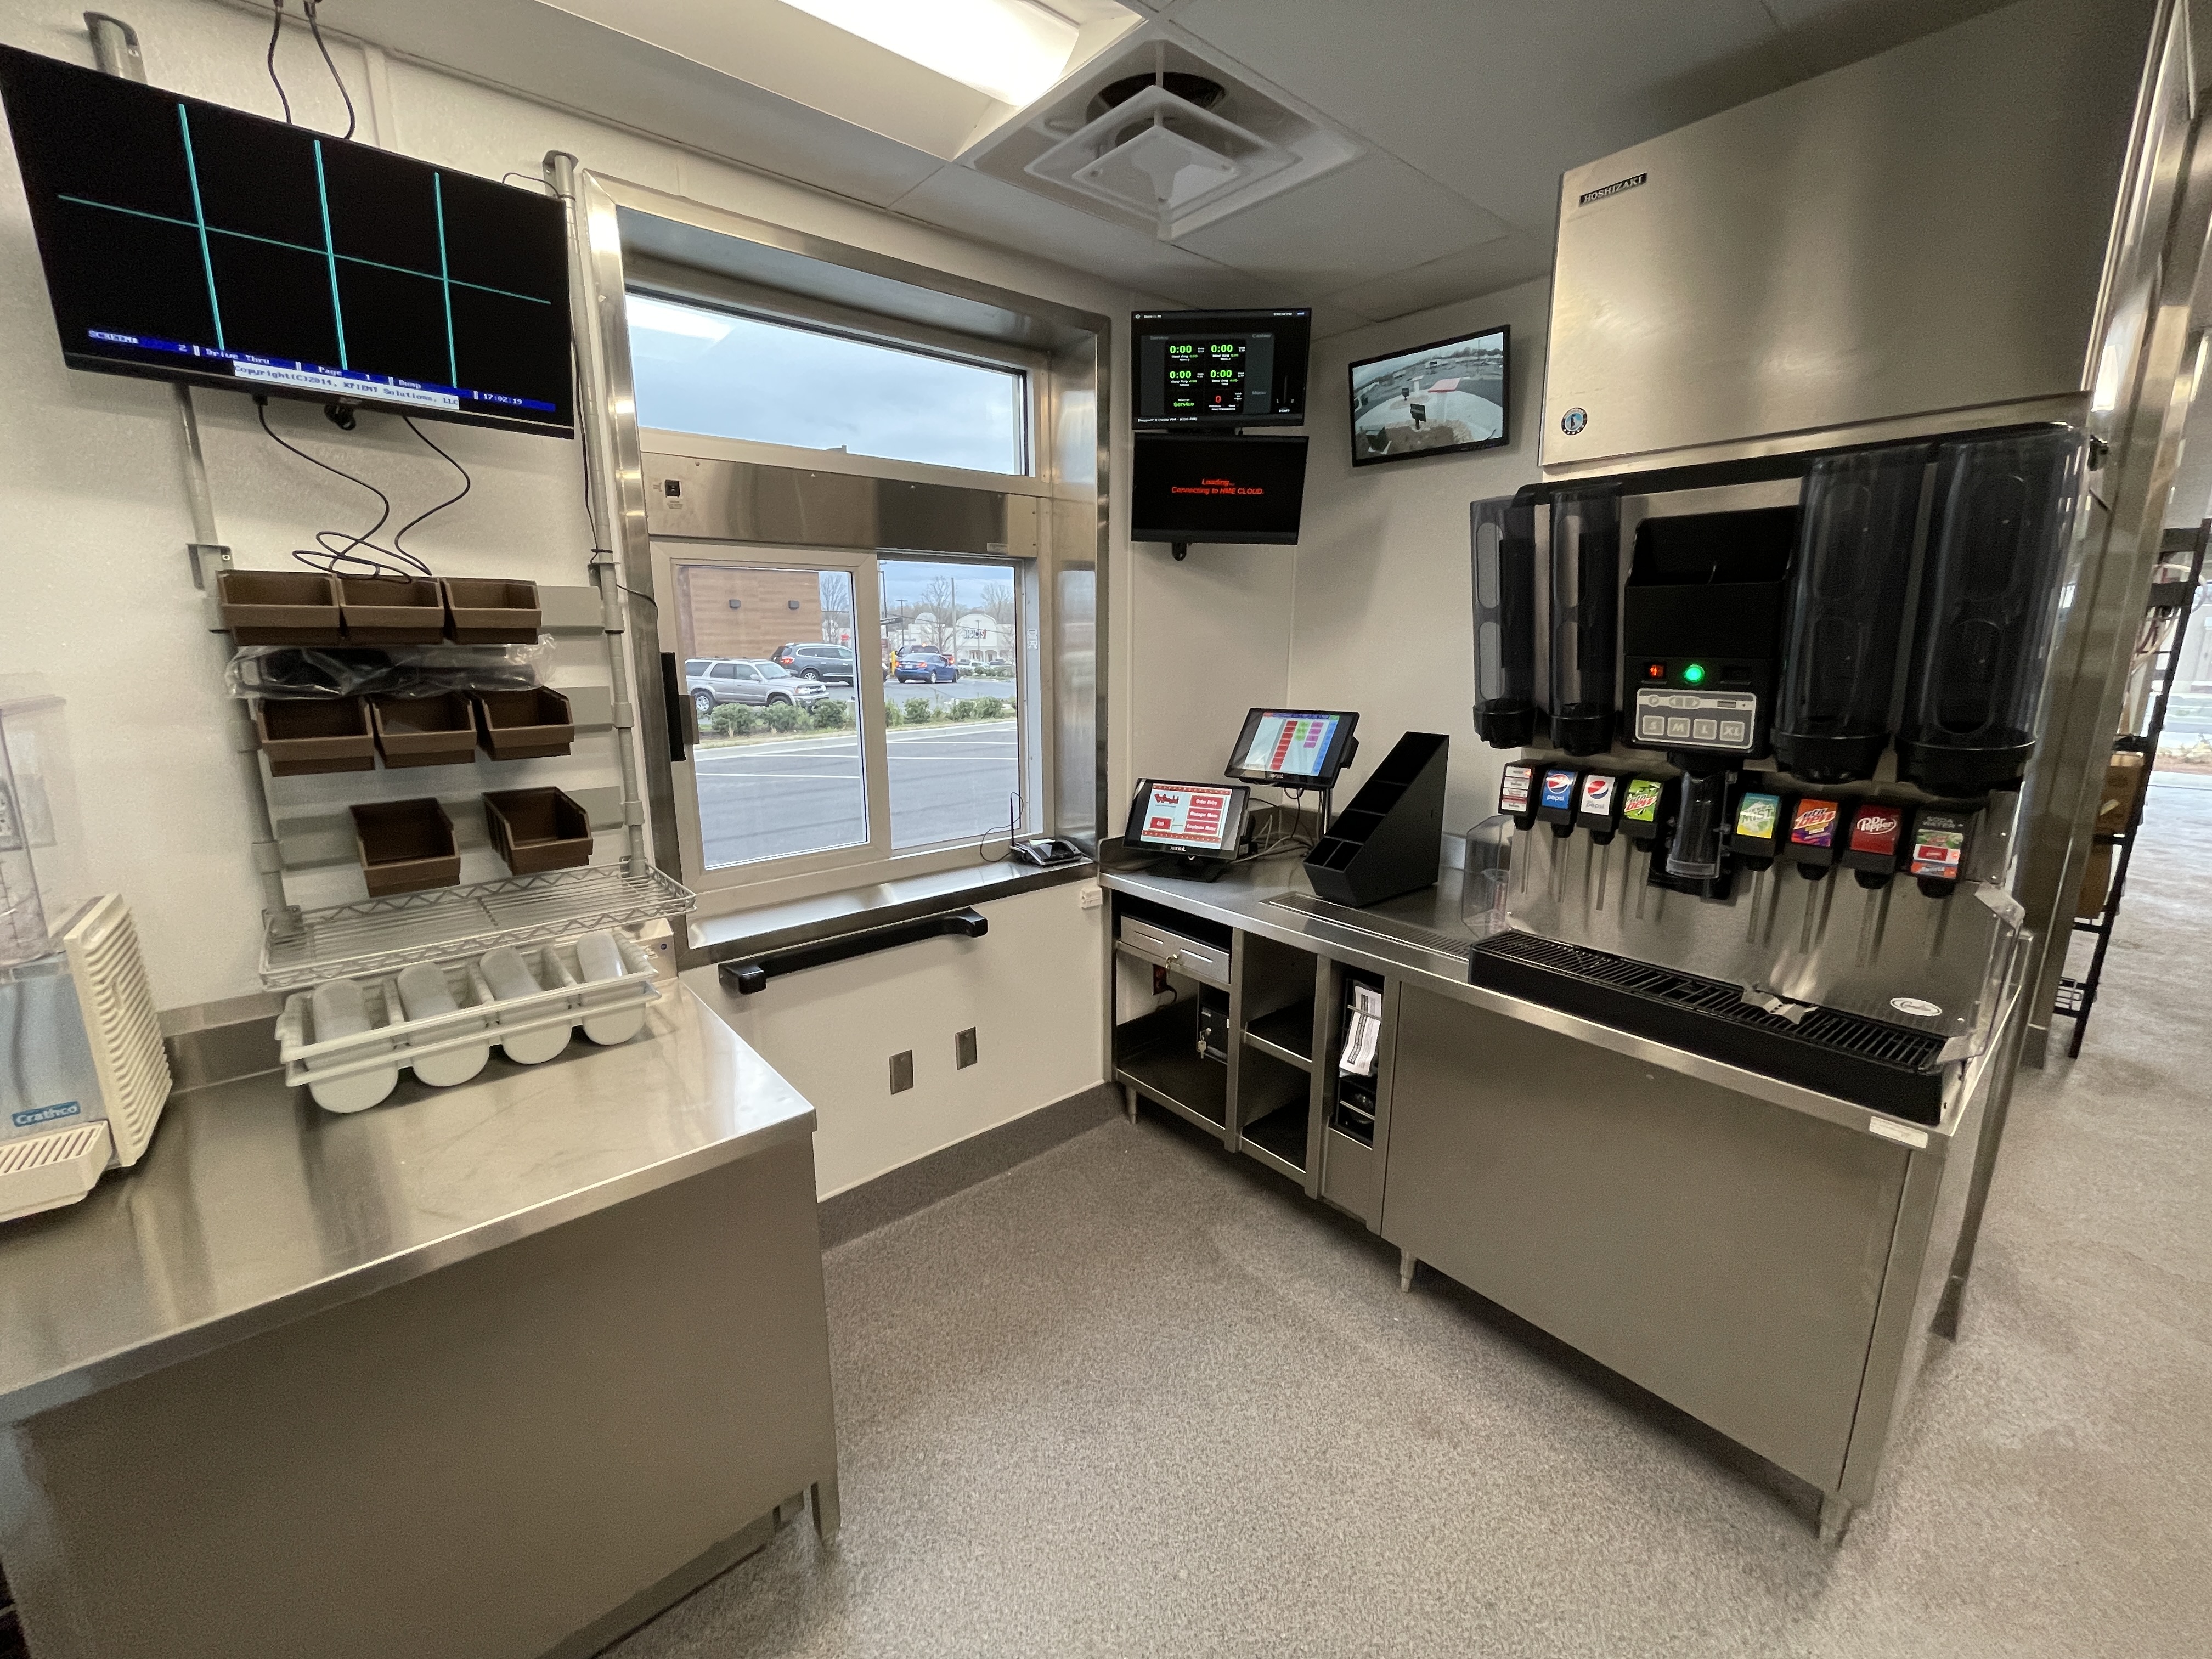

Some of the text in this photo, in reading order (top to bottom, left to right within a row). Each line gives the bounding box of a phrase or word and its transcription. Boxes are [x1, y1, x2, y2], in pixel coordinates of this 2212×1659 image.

[1583, 175, 1643, 204] HOSHIZAKI
[178, 344, 187, 352] 2
[1170, 345, 1192, 354] 0:00
[1211, 345, 1233, 353] 0:00
[206, 348, 270, 364] Drive Thru
[318, 366, 342, 377] Page
[1170, 370, 1192, 379] 0:00
[1210, 370, 1232, 378] 0:00
[443, 397, 458, 405] LLC
[483, 393, 522, 405] 17:02:19
[1215, 395, 1221, 403] 0
[1172, 487, 1210, 495] Connecting
[1649, 721, 1741, 736] S M L XL
[1742, 809, 1773, 823] MIST
[1861, 818, 1893, 832] Pepper
[16, 1106, 77, 1124] Crathco
